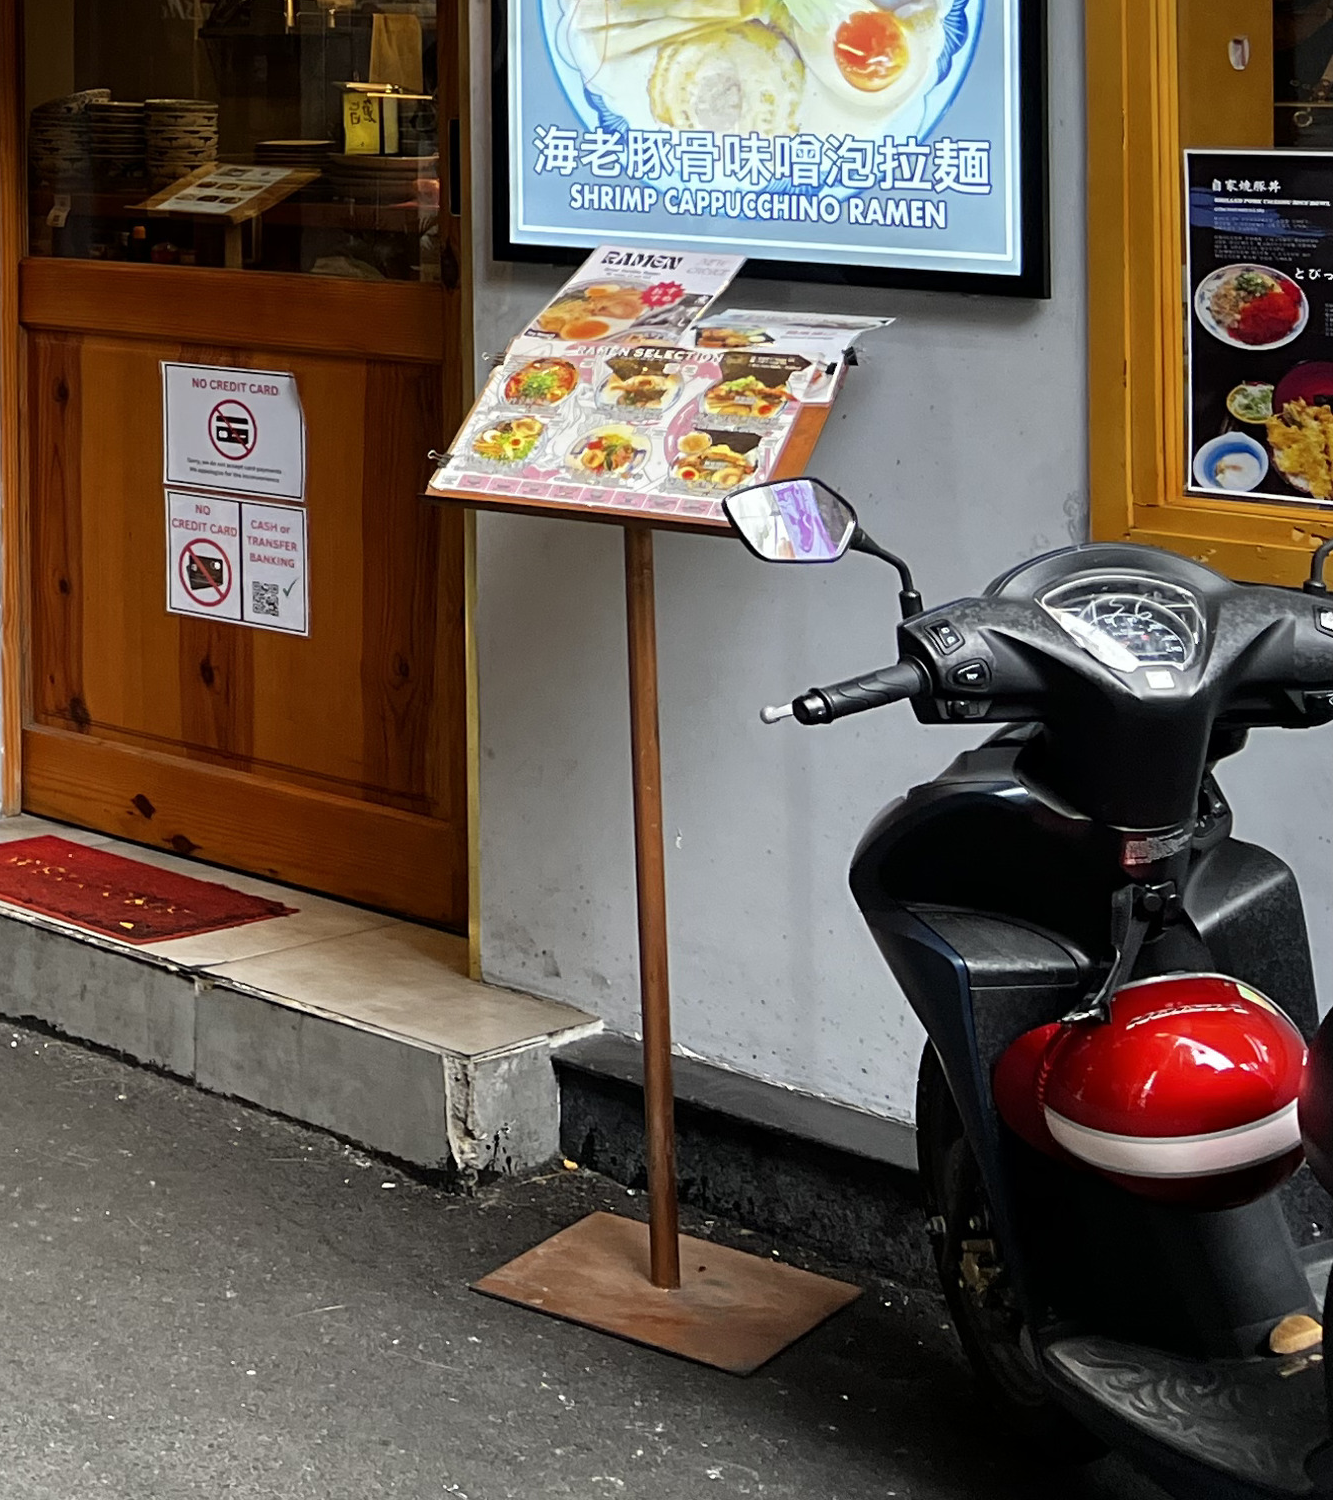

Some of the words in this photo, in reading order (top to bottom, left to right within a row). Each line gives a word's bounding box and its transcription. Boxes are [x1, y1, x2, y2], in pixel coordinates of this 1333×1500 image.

[568, 183, 657, 214] SHRIMP
[663, 186, 841, 224] CAPPUCCHINO
[847, 196, 948, 229] RAMEN
[600, 250, 684, 270] RAMEN
[632, 347, 725, 364] SELECTION
[191, 377, 208, 390] NO
[209, 379, 247, 393] CREDIT
[249, 383, 279, 396] CARD
[194, 504, 211, 516] NO
[171, 517, 208, 533] CREDIT
[209, 523, 238, 538] CARD
[250, 519, 278, 533] CASH
[279, 525, 291, 534] or
[246, 535, 298, 552] TRANSFER
[249, 552, 295, 569] BANKING
